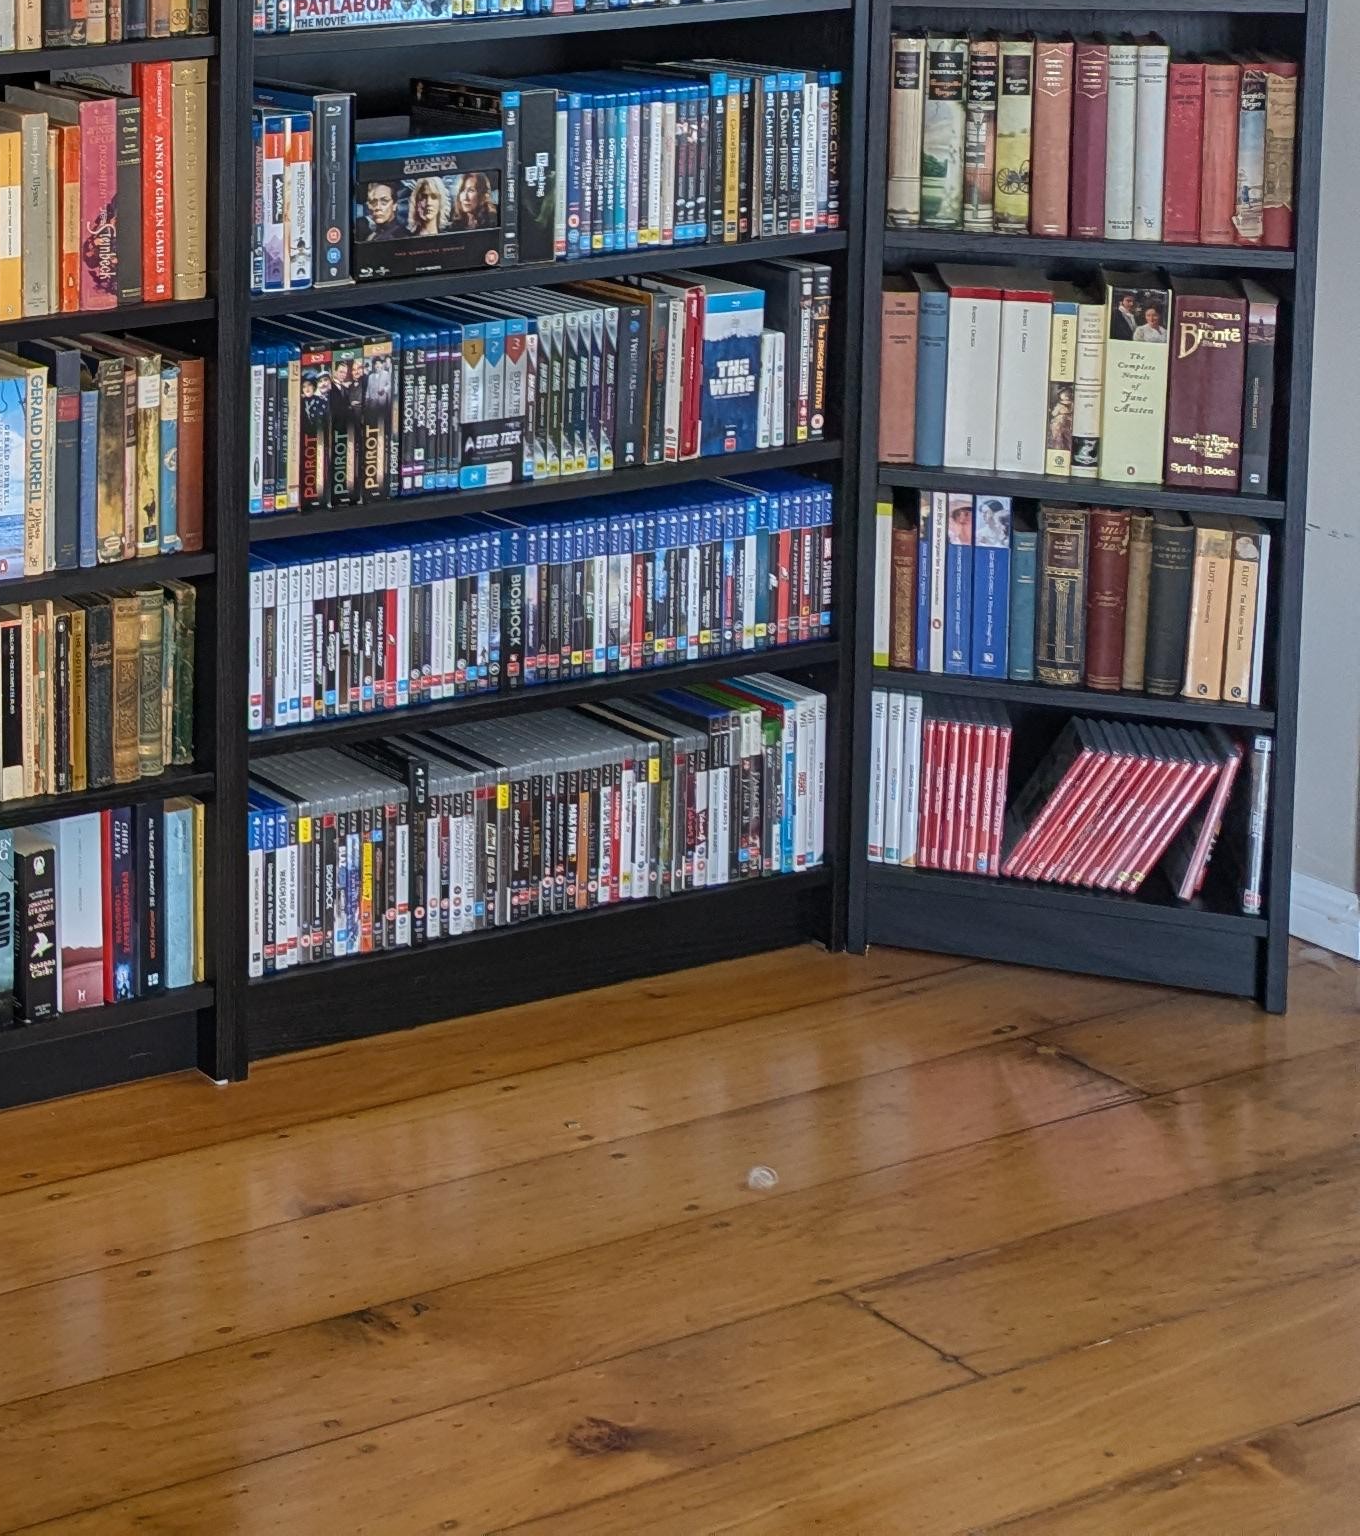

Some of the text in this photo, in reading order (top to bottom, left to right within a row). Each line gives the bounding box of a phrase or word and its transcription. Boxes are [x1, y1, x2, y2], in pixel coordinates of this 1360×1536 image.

[296, 16, 346, 27] THE MOVIE
[154, 135, 165, 276] ANNE OF GREEN GABLES
[1182, 310, 1241, 321] FOUR NOVELS
[1178, 326, 1241, 359] Brontë
[709, 358, 755, 395] THE WIRE
[1113, 391, 1155, 416] Jane Austen
[28, 375, 43, 504] GERALD DURRELL
[475, 427, 523, 447] STAR TREK
[305, 434, 319, 498] POIROT
[334, 430, 348, 495] POIROT
[1170, 463, 1236, 478] Spring Books
[510, 574, 521, 647] BIOSHOCK
